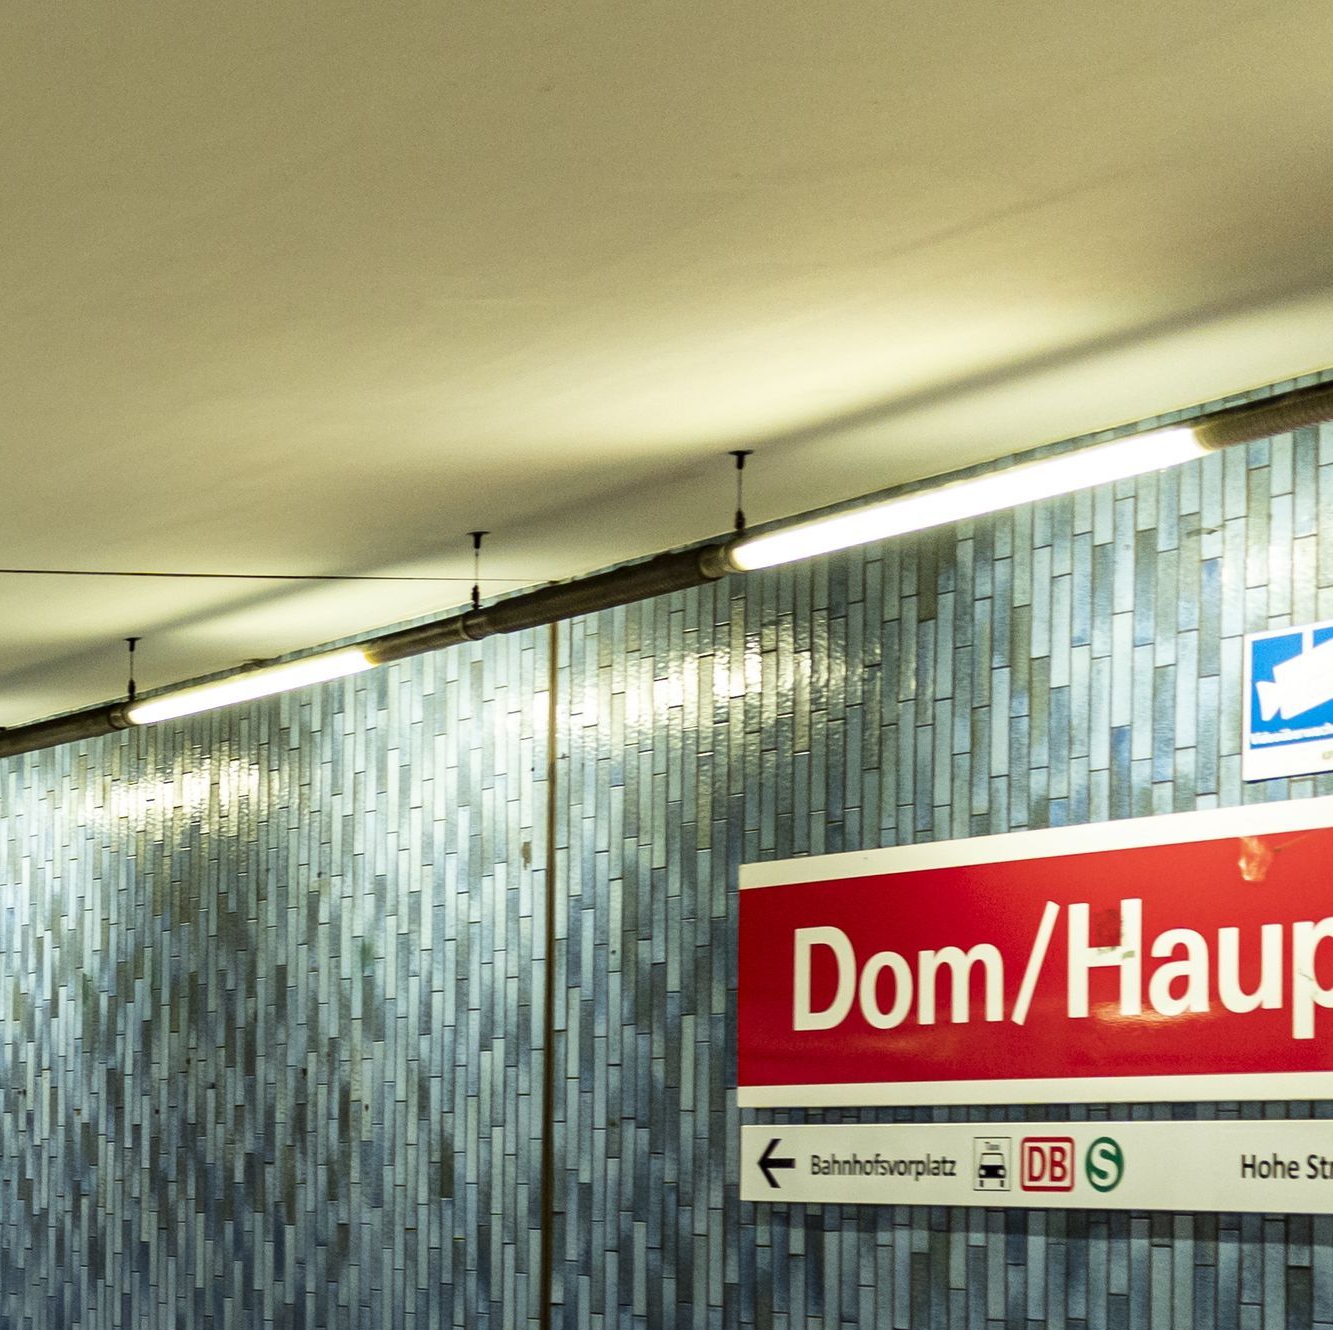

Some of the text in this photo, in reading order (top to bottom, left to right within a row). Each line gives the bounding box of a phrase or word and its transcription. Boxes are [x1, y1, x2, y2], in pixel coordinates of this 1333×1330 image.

[810, 1153, 957, 1181] Bahnhofsvorplatz
[1027, 1145, 1068, 1182] DB
[1088, 1140, 1121, 1189] S
[1240, 1153, 1300, 1180] Hohe
